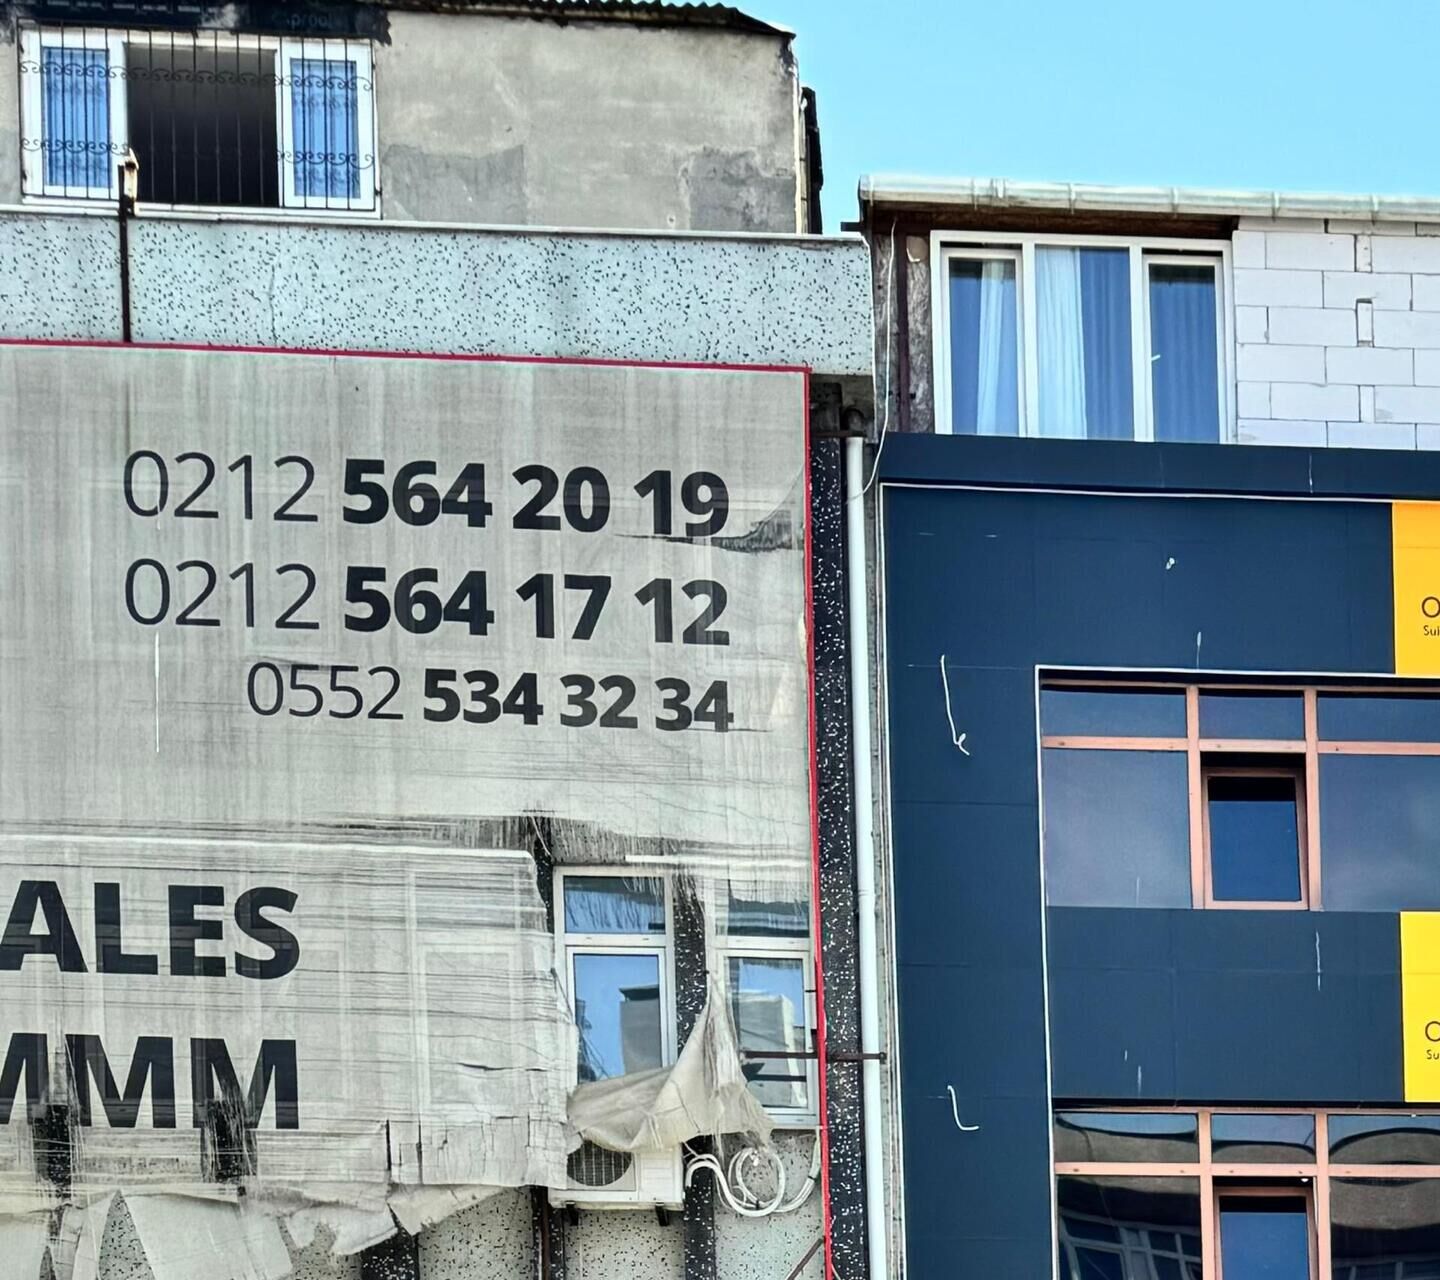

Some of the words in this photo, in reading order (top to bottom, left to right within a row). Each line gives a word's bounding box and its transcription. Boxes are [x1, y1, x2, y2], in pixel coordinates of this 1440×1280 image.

[124, 450, 316, 522] 0212
[343, 458, 492, 528] 564
[513, 465, 611, 533] 20
[634, 470, 730, 538] 19
[126, 558, 319, 630] 0212
[345, 566, 495, 637] 564
[516, 573, 612, 642] 17
[635, 578, 730, 646] 12
[248, 661, 403, 719] 0552
[423, 668, 543, 725] 534
[560, 674, 638, 729] 32
[655, 678, 733, 733] 34
[0, 880, 300, 979] ALES
